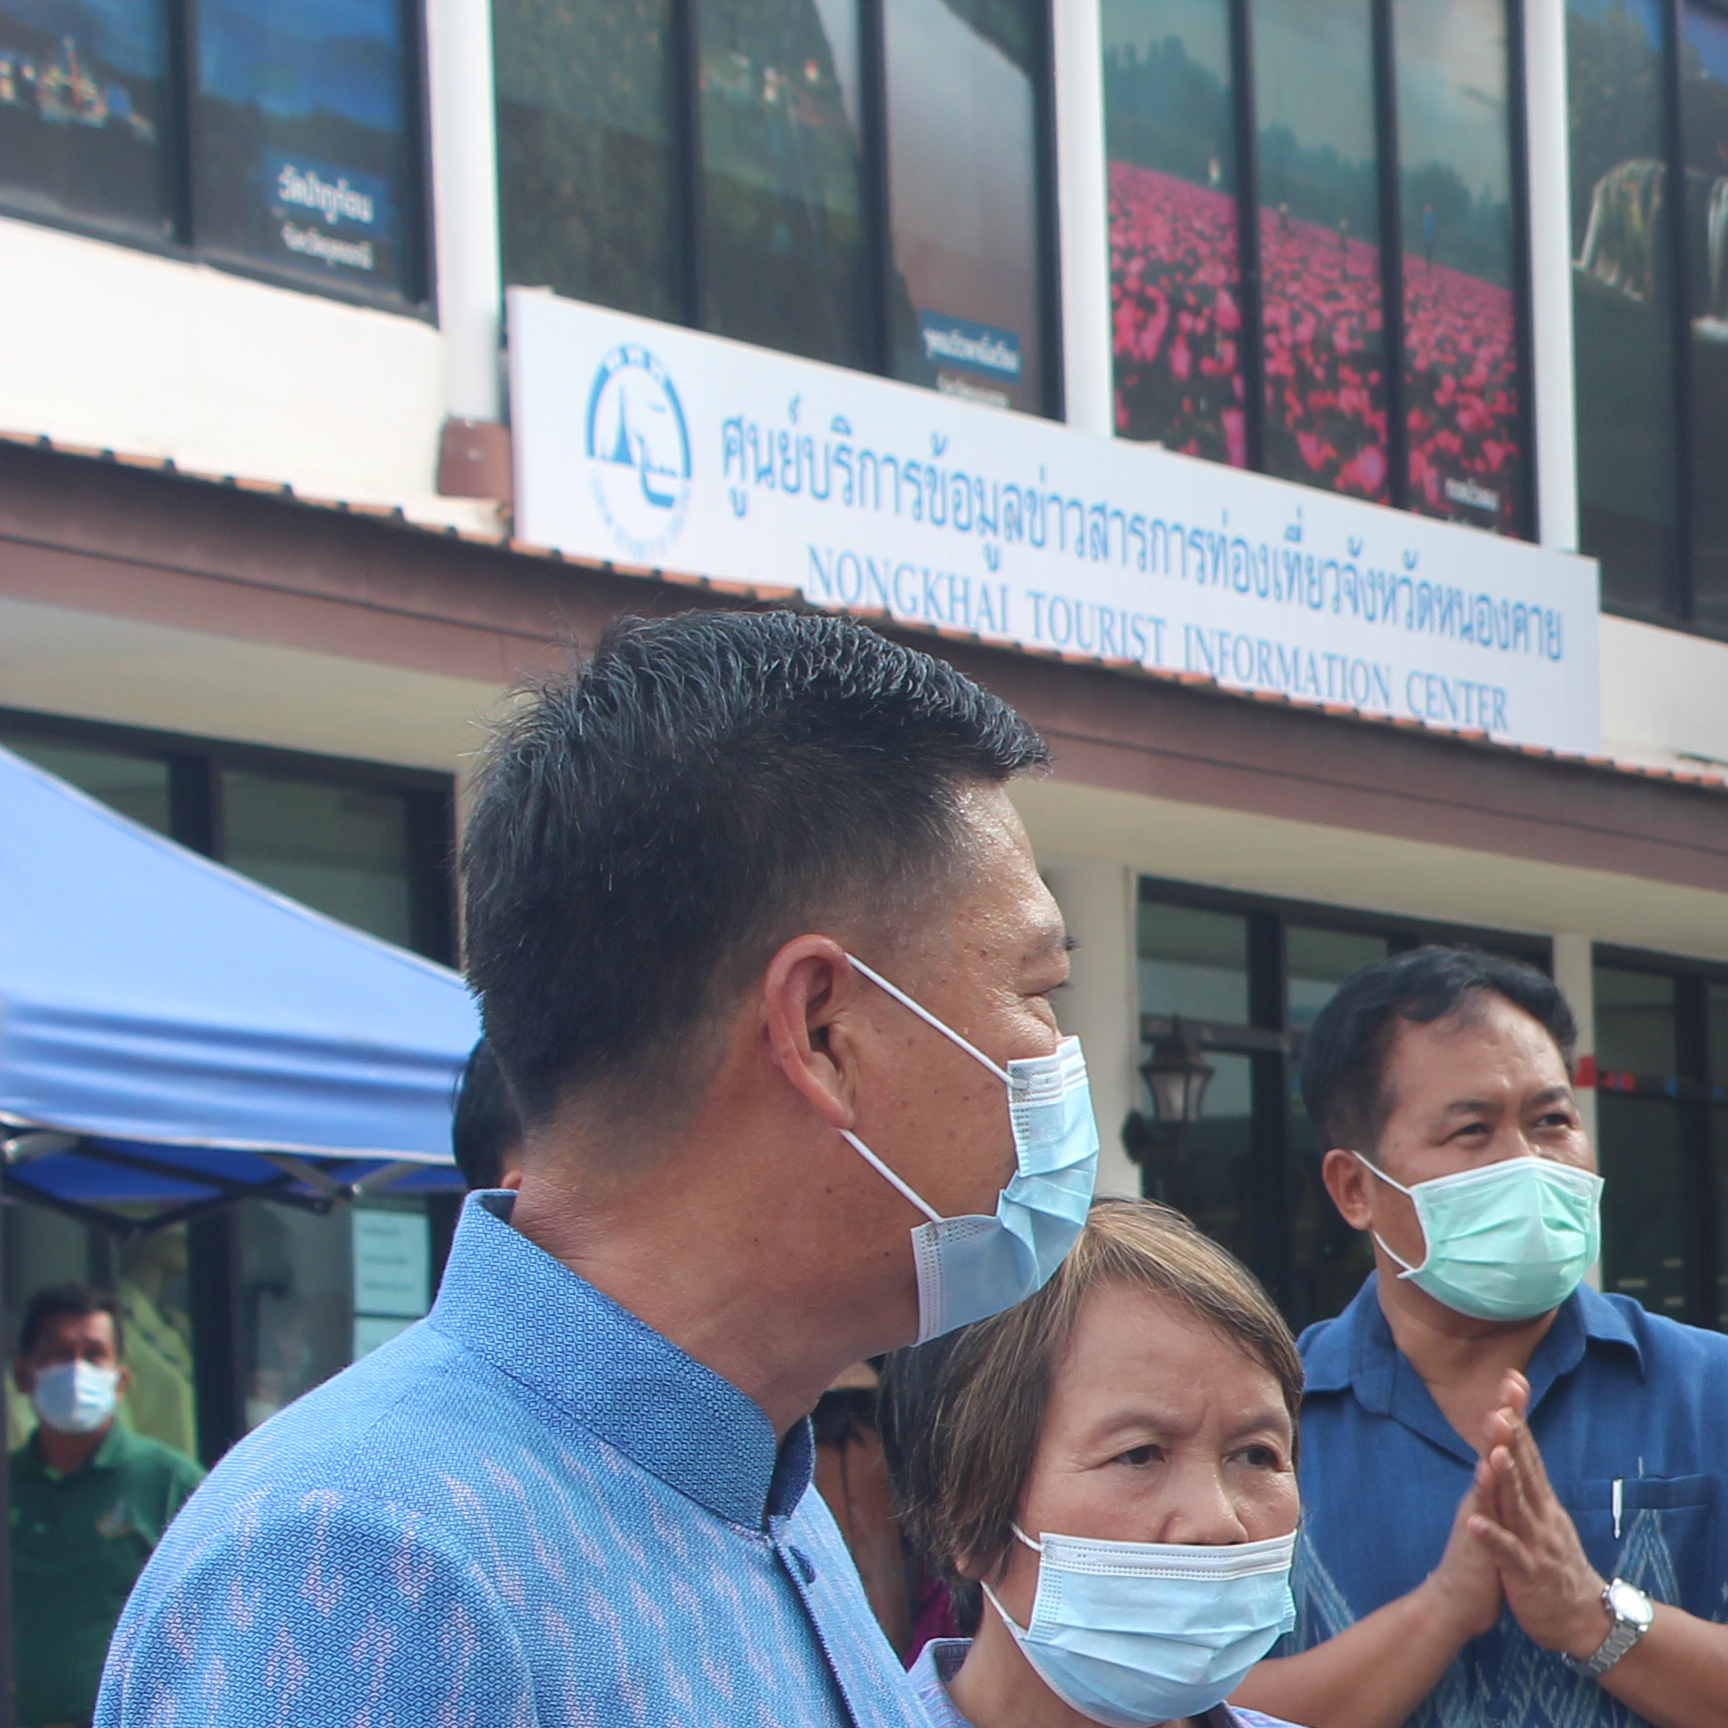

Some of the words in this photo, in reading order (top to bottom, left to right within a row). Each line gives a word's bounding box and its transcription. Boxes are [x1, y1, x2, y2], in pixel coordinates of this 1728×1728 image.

[721, 394, 1563, 661] ศูนย์บริการข้อมูลข่าวสารการท่องเที่ยวจังหวัดหนองคาย
[806, 544, 1010, 635] NONGKHAI
[1027, 589, 1168, 666] TOURIST
[1183, 623, 1391, 711] INFORMATION
[1405, 669, 1509, 731] CENTER
